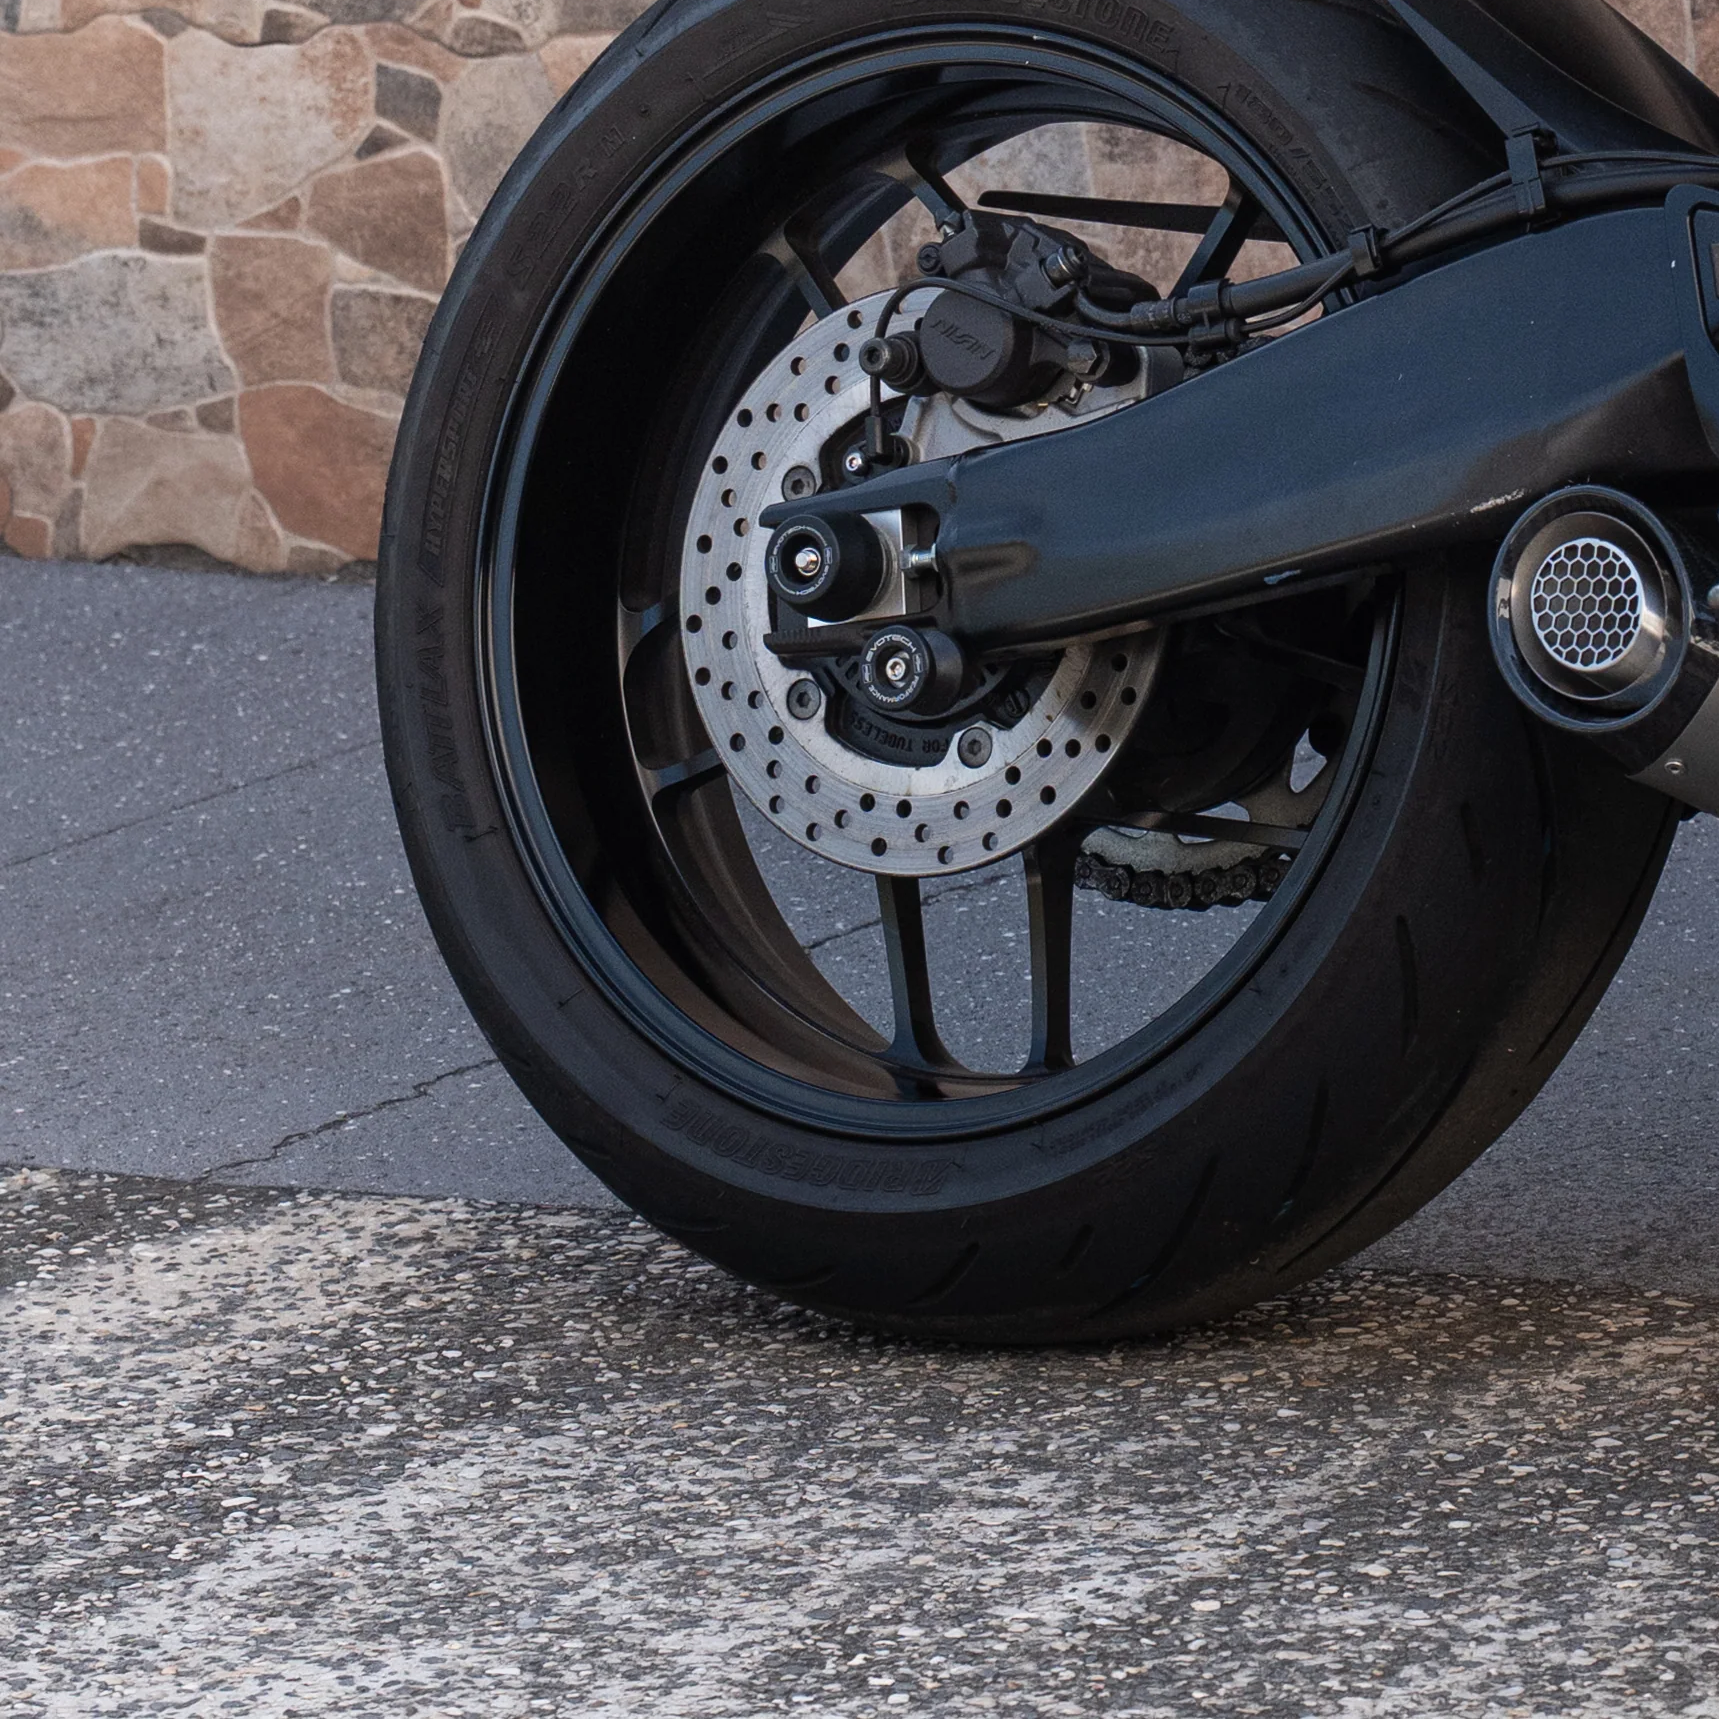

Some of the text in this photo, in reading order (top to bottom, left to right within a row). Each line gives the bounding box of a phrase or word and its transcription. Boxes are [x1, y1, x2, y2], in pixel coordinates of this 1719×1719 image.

[865, 633, 917, 663] EVOTECH
[414, 596, 478, 833] BATTLAX
[658, 1097, 953, 1197] BRIDGESTONE
